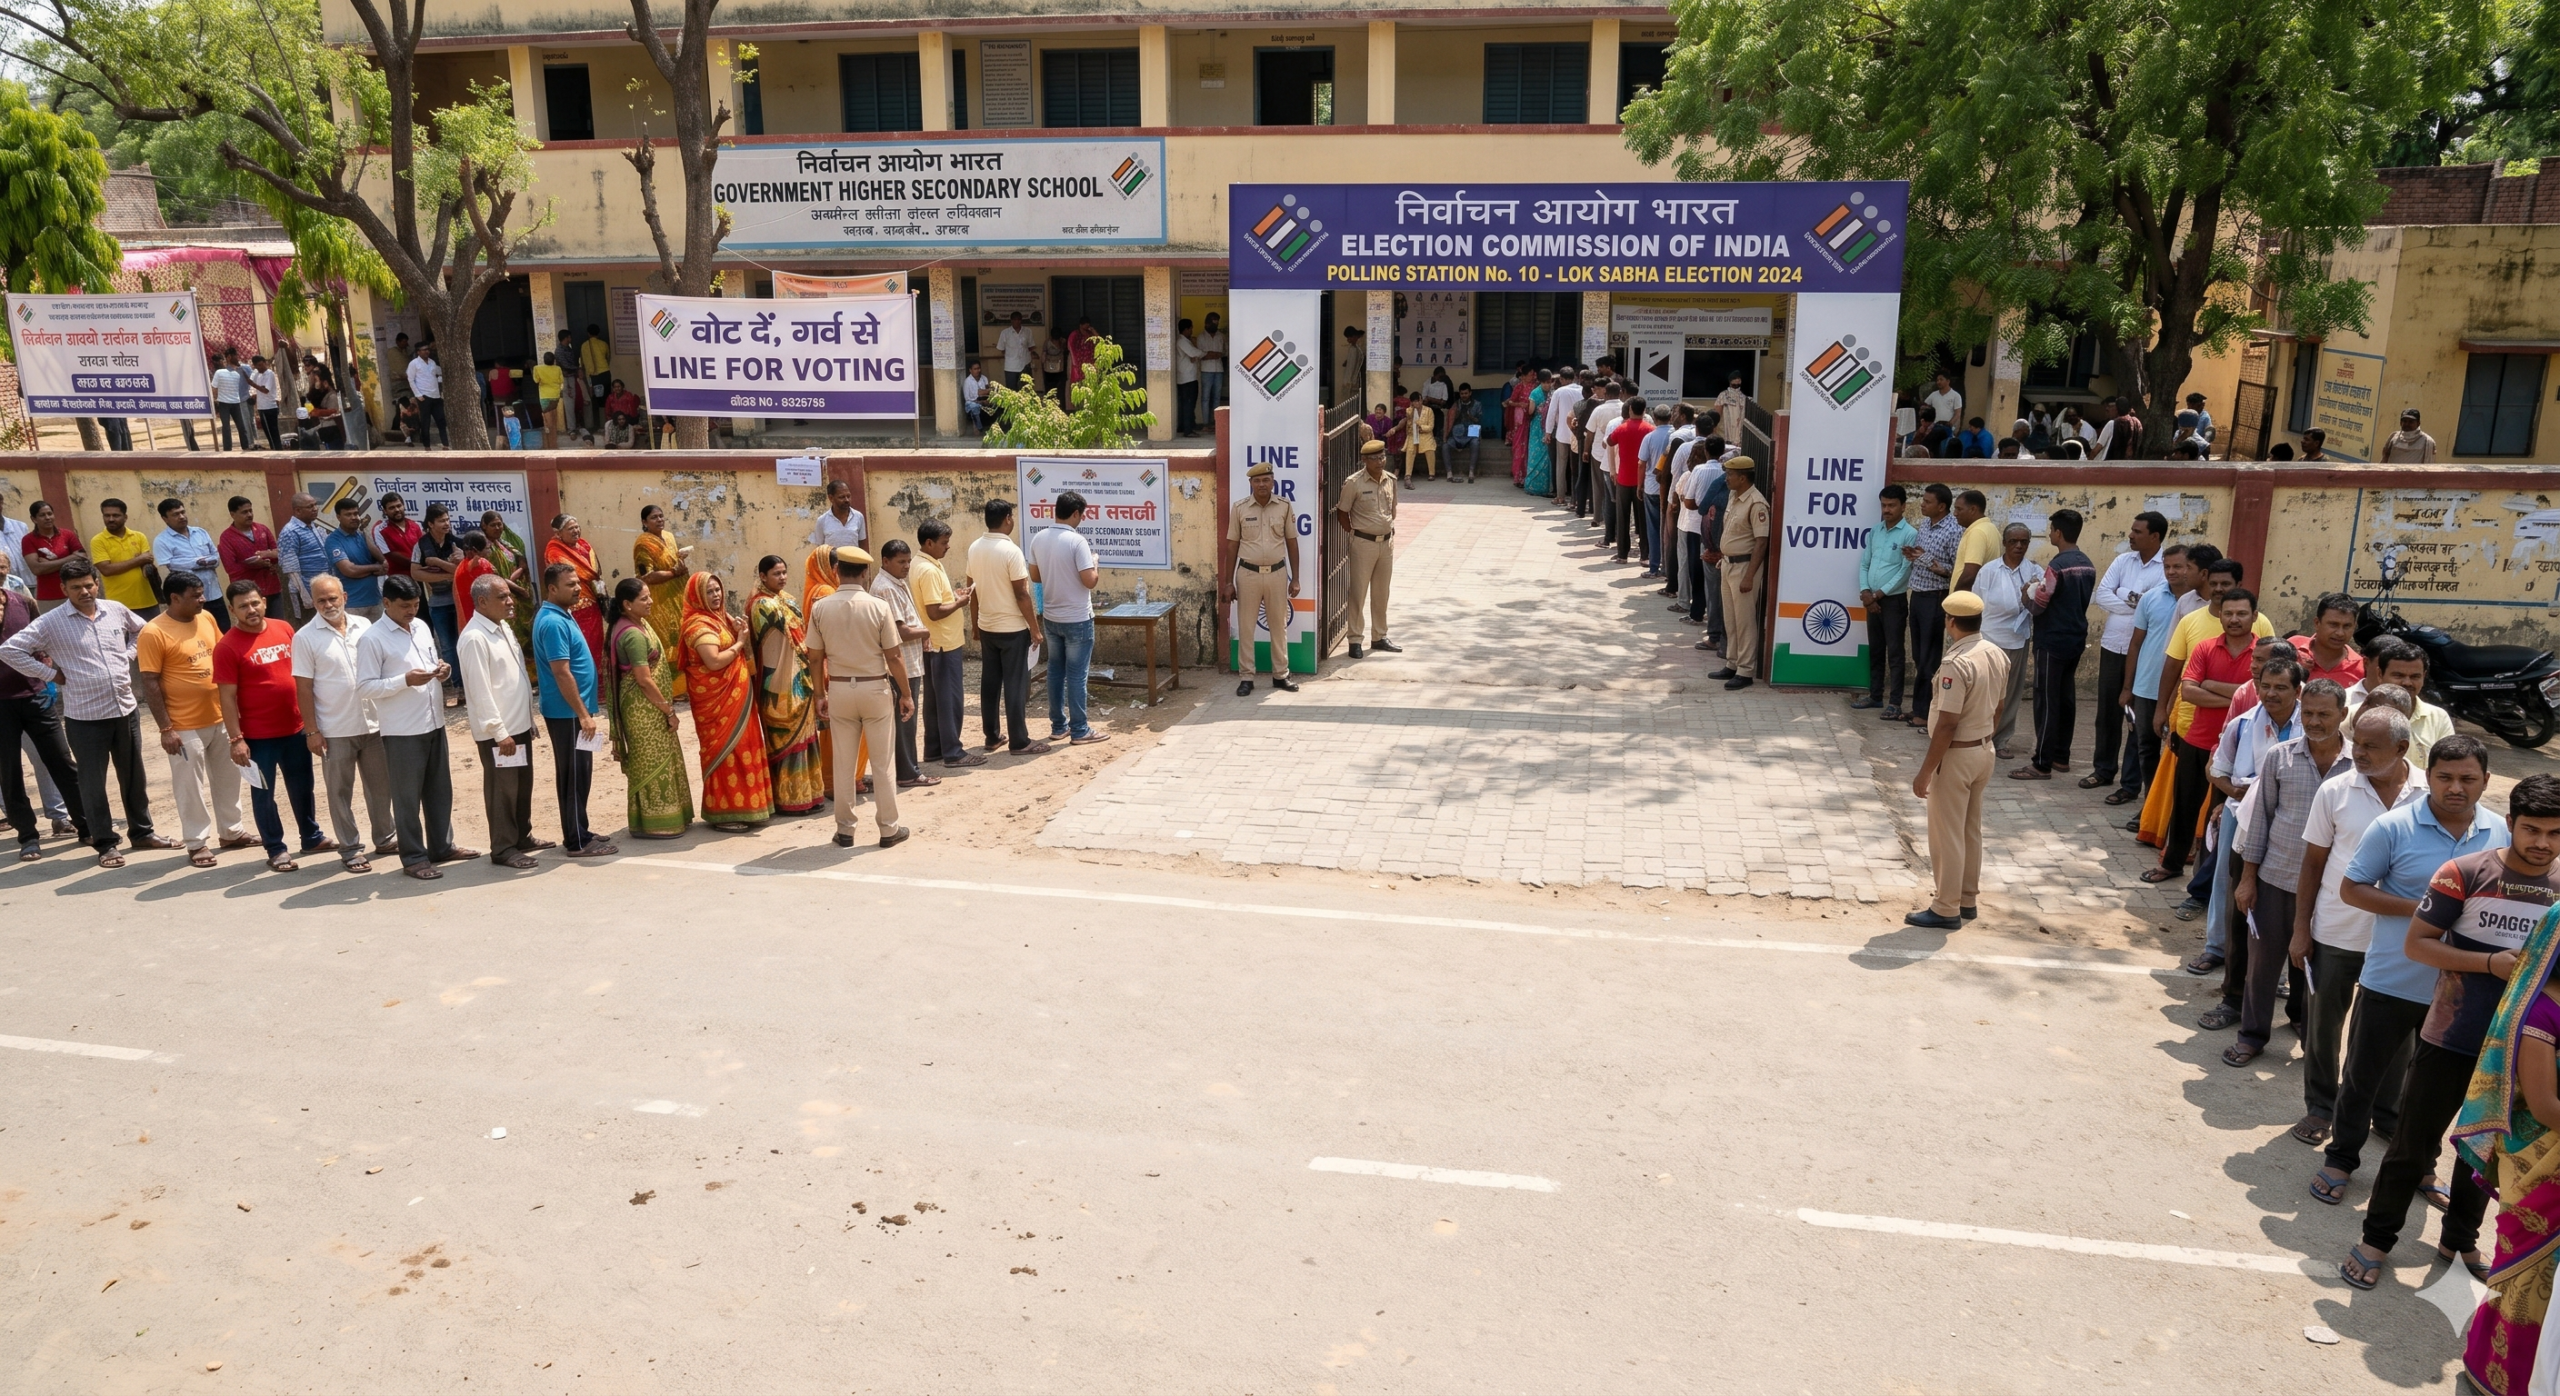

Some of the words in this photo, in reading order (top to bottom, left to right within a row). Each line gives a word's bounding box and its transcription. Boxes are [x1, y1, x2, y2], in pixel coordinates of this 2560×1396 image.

[797, 149, 871, 174] निर्वाचन
[878, 148, 942, 173] आयोग
[950, 152, 1003, 171] भारत
[714, 181, 833, 203] GOVERNMENT
[839, 180, 906, 201] HIGHER
[911, 178, 1022, 200] SECONDARY
[1027, 176, 1103, 198] SCHOOL
[1395, 190, 1520, 225] निर्वाचन
[1532, 189, 1639, 225] आयोग
[1652, 199, 1739, 225] भारत
[1342, 234, 1473, 257] ELECTION
[1482, 234, 1666, 257] COMMISSION
[1669, 234, 1705, 257] OF
[1714, 235, 1790, 257] INDIA
[1327, 264, 1400, 282] POLLING
[1406, 265, 1481, 282] STATION
[1486, 265, 1512, 282] No.
[1519, 266, 1539, 282] 10
[1558, 266, 1594, 283] LOK
[1599, 266, 1659, 283] SABHA
[1665, 266, 1752, 283] ELECTION
[1758, 267, 1802, 283] 2024
[691, 311, 742, 345] वोट
[748, 312, 781, 348] दें,
[791, 311, 843, 345] गर्व
[850, 311, 881, 345] से
[653, 356, 717, 380] LINE
[726, 357, 784, 381] FOR
[792, 357, 905, 382] VOTING
[1246, 445, 1299, 468] LINE
[1807, 457, 1864, 481] LINE
[1807, 492, 1857, 516] FOR
